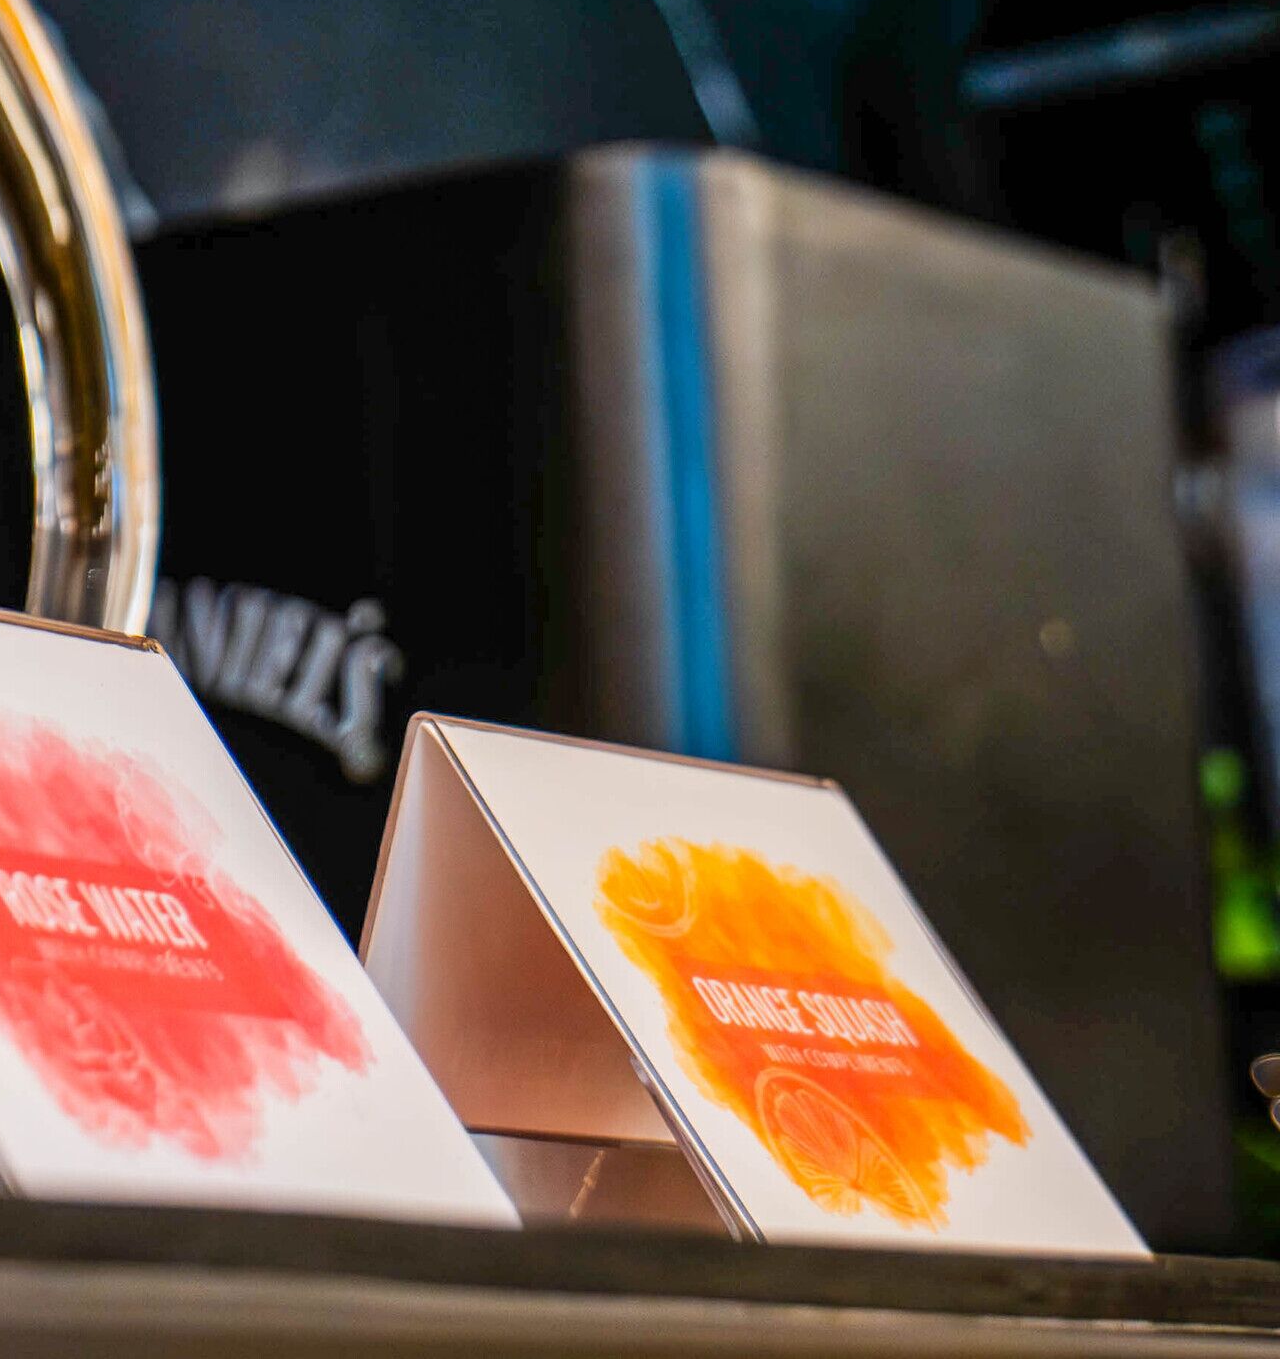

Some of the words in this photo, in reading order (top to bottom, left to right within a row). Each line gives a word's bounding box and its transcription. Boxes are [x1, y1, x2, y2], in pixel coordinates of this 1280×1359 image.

[75, 880, 209, 951] WATER
[692, 976, 815, 1036] ORANGE
[796, 990, 920, 1048] SQUASH
[760, 1043, 807, 1065] WITH
